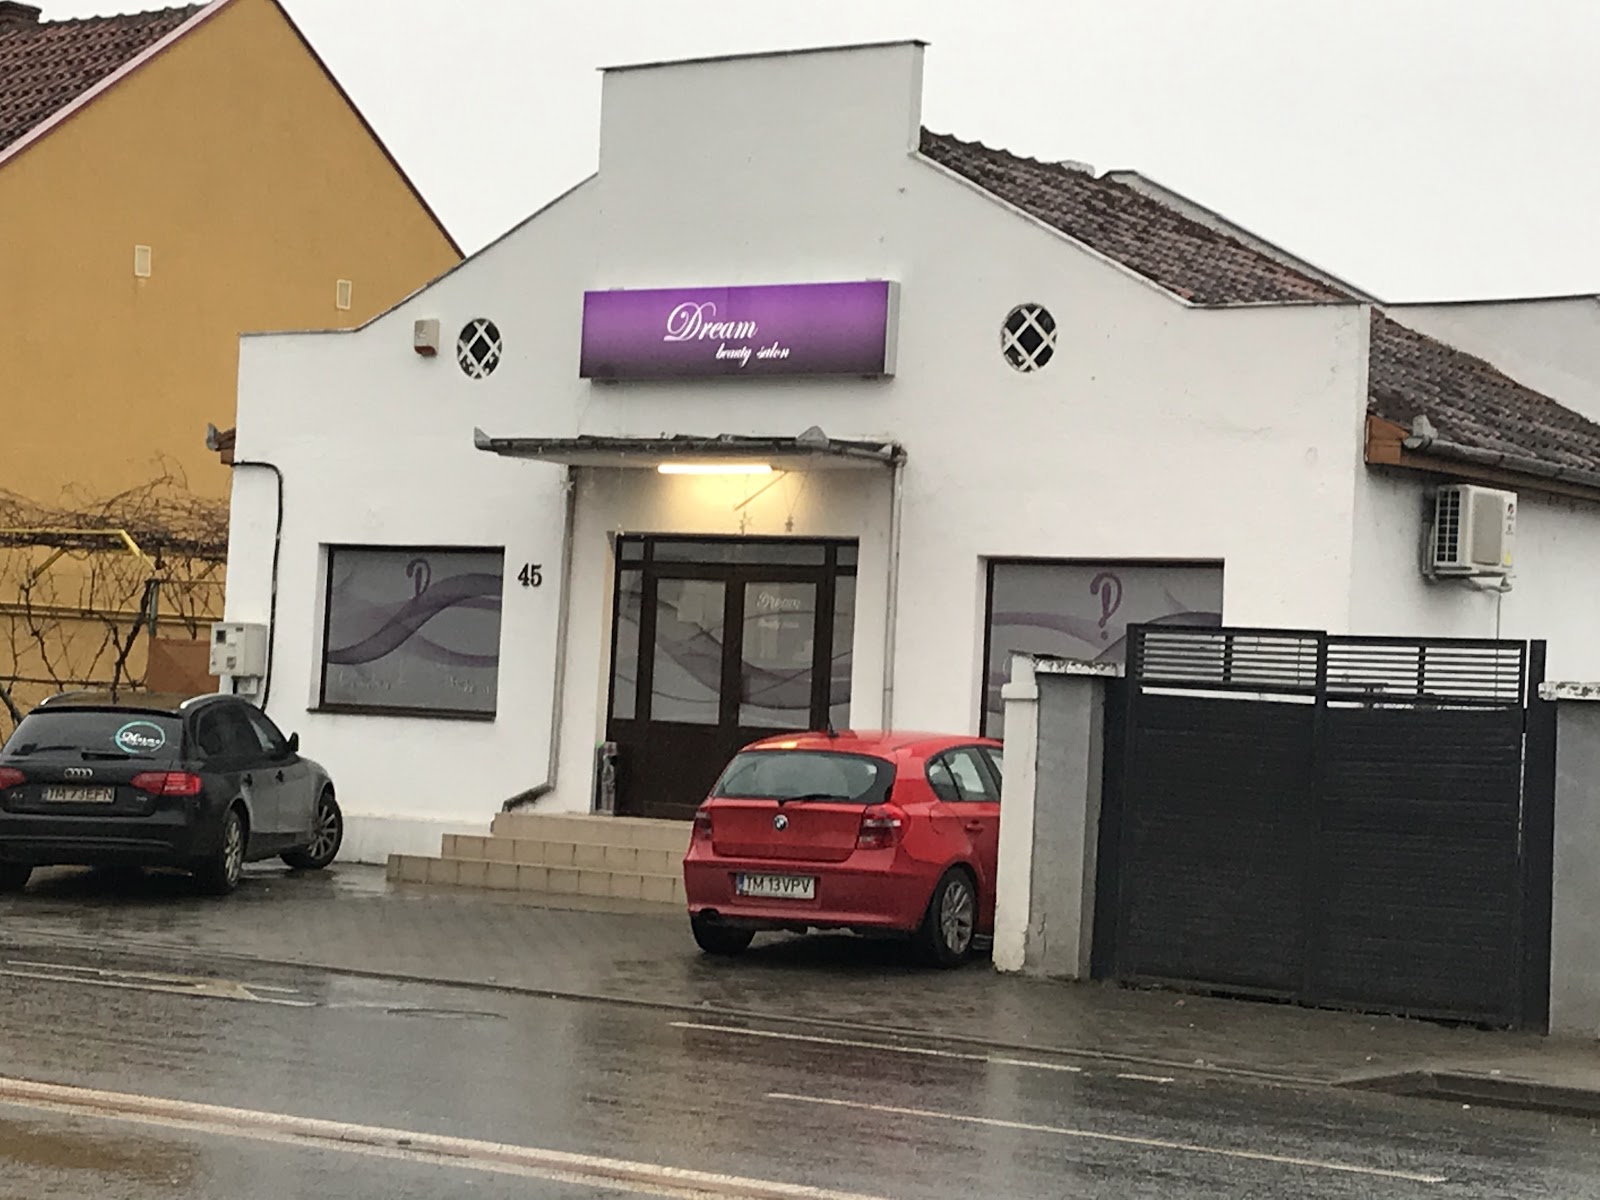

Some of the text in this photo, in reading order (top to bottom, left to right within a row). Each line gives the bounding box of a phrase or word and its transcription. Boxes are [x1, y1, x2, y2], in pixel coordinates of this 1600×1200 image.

[663, 301, 759, 341] Dream
[715, 341, 790, 368] beauty salon
[518, 562, 542, 587] 45
[746, 875, 764, 891] TM
